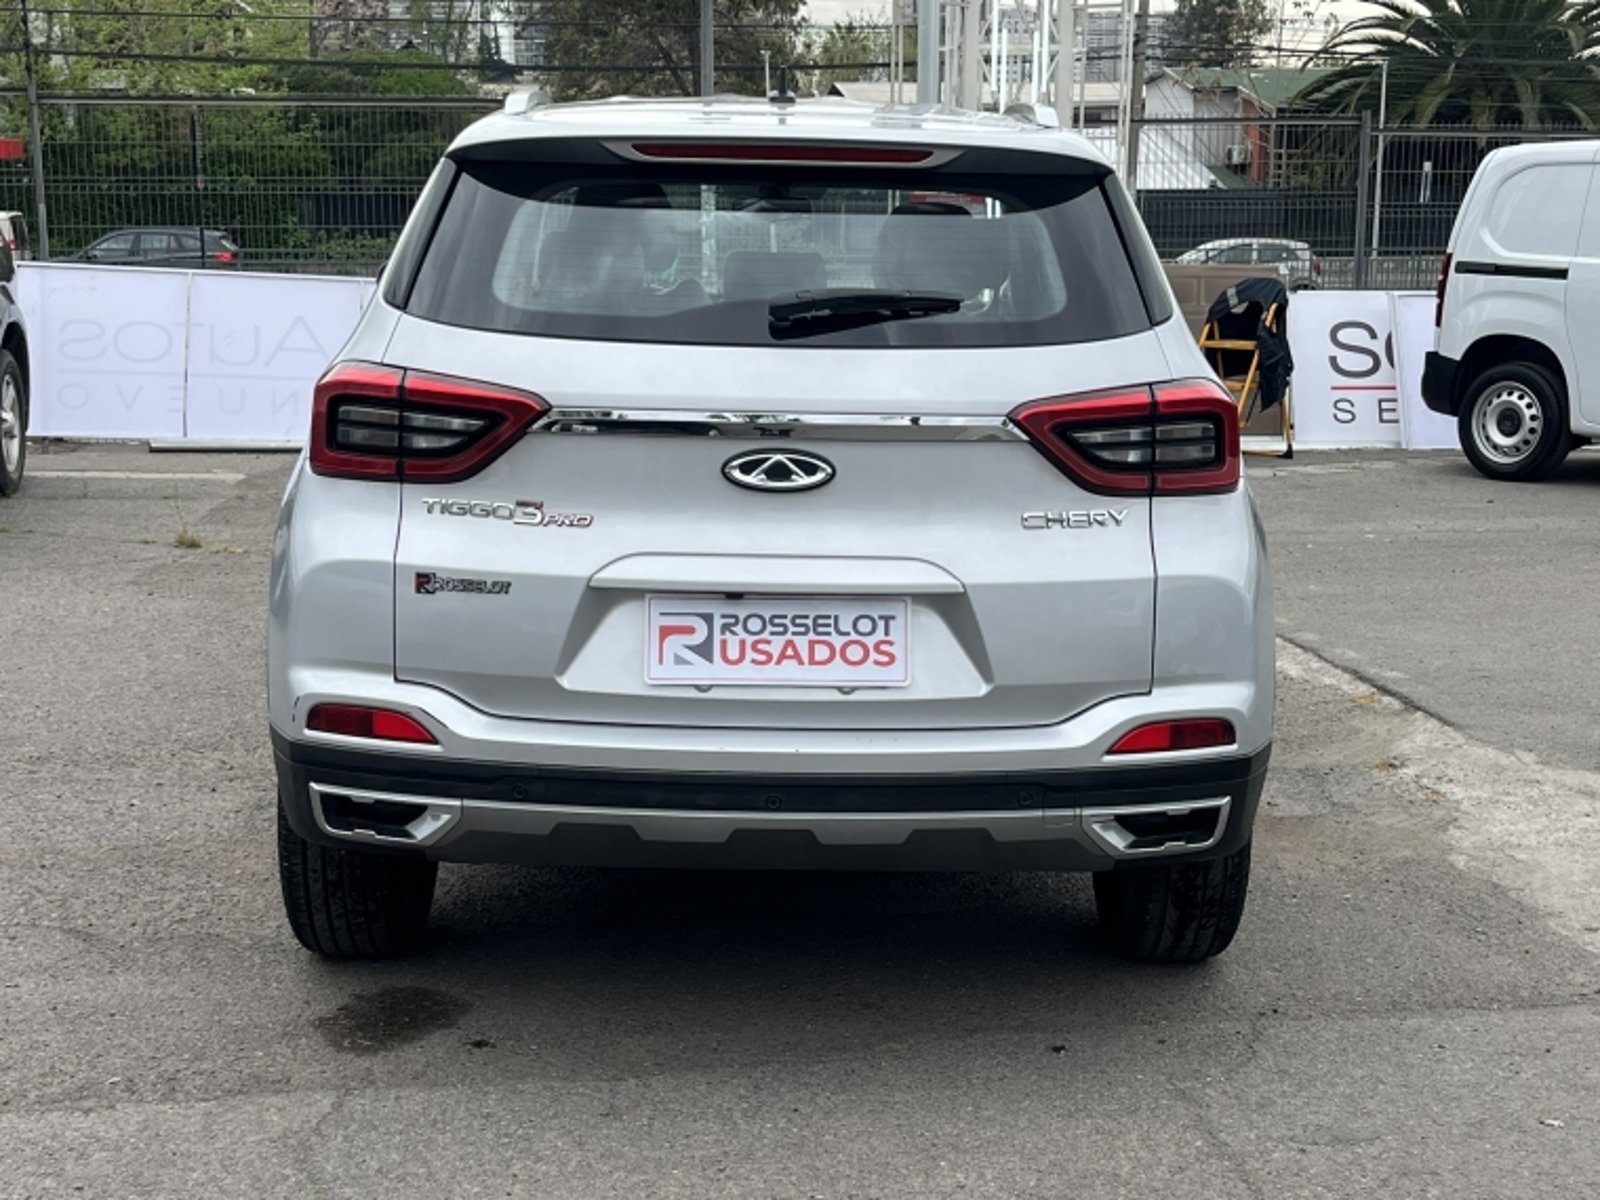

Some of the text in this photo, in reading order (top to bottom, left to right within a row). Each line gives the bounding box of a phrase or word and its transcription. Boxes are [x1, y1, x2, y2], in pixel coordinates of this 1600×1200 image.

[1328, 320, 1396, 379] S
[1021, 508, 1128, 530] CHERY
[720, 613, 896, 637] ROSSELOT
[720, 638, 896, 667] USADOS
